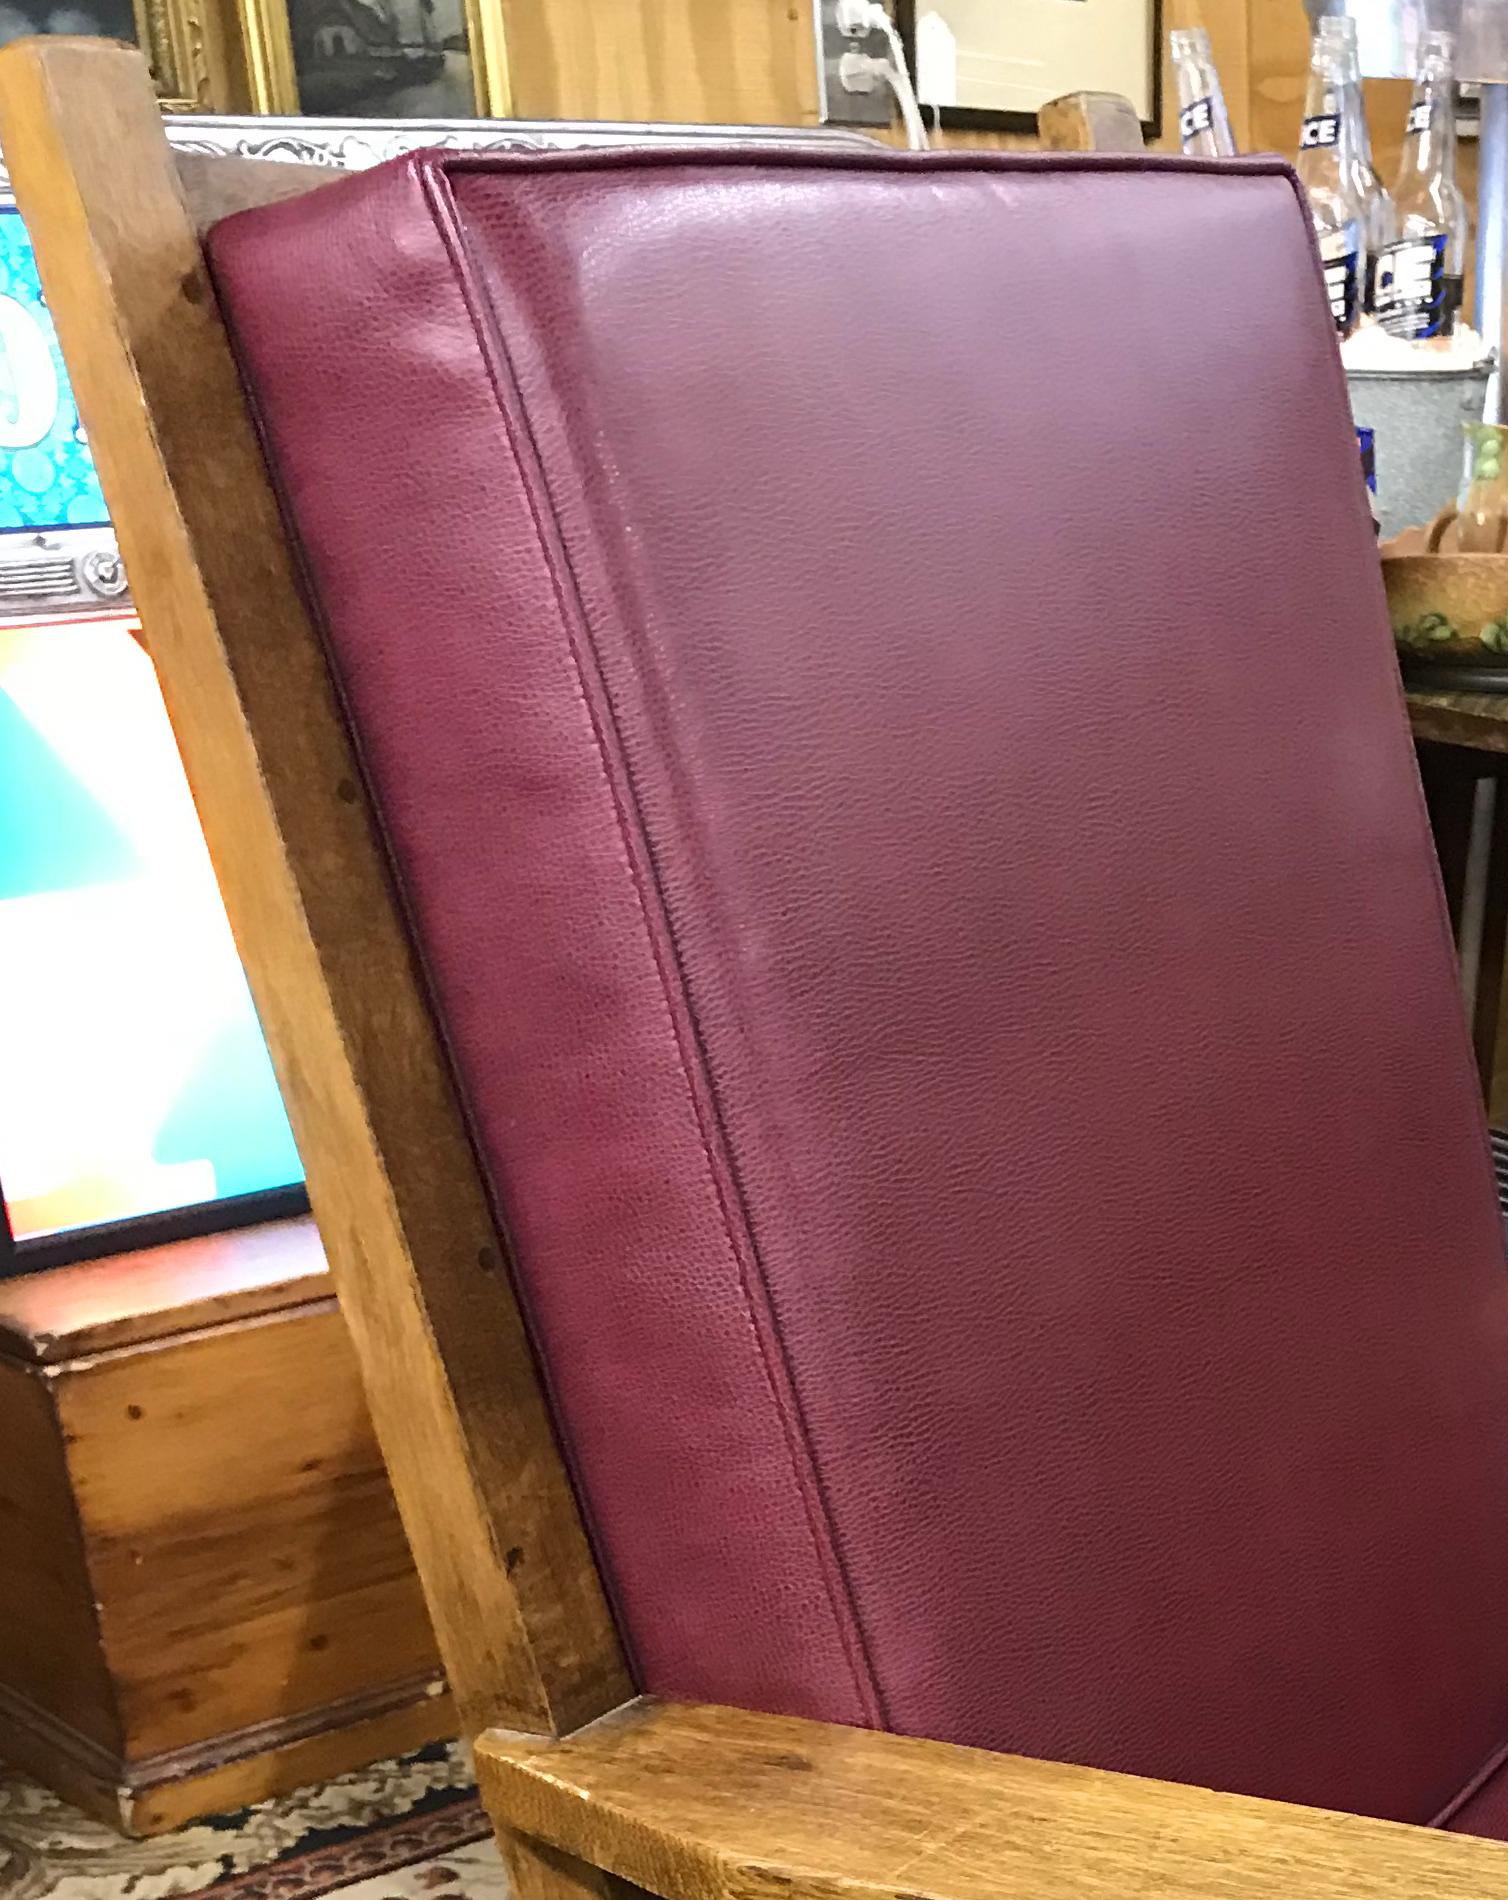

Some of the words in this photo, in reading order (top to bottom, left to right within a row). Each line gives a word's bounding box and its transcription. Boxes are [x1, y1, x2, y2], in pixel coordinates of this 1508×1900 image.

[1180, 102, 1209, 136] CE
[1300, 119, 1337, 145] CE
[1375, 245, 1435, 307] CE
